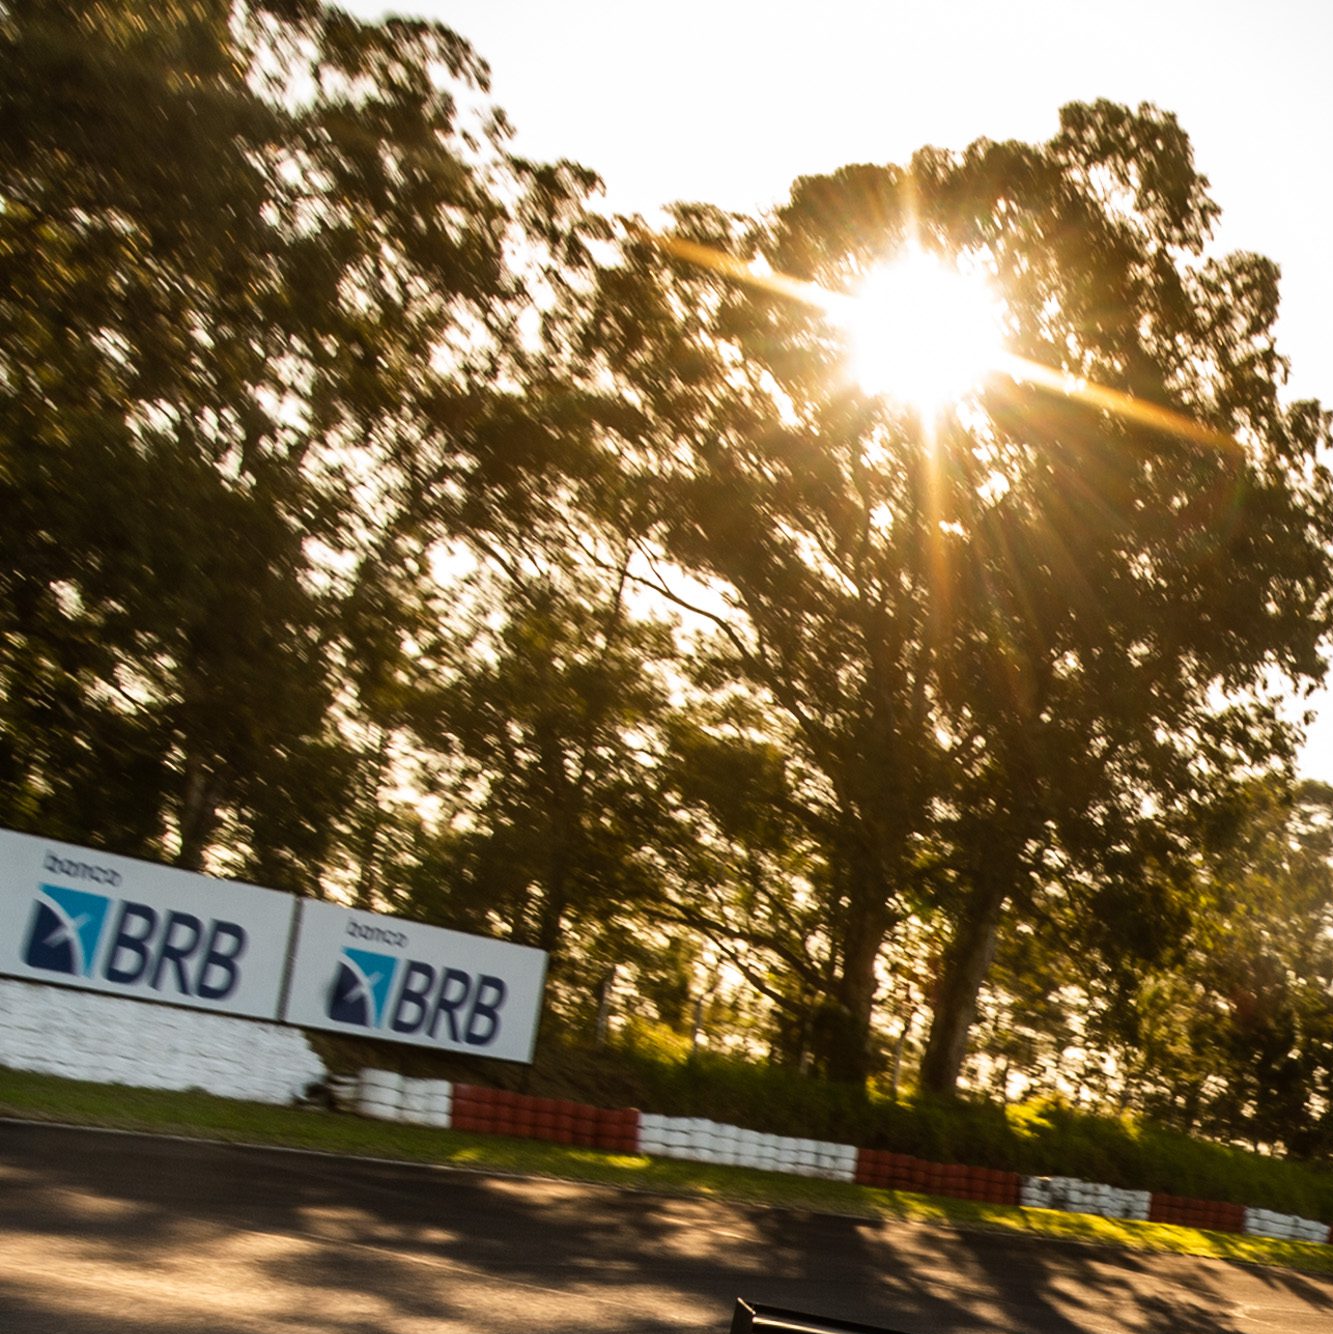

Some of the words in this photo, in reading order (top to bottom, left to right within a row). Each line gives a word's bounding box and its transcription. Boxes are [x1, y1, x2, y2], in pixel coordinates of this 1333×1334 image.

[44, 850, 123, 887] banco
[102, 900, 247, 999] BRB
[390, 959, 508, 1046] BRB
